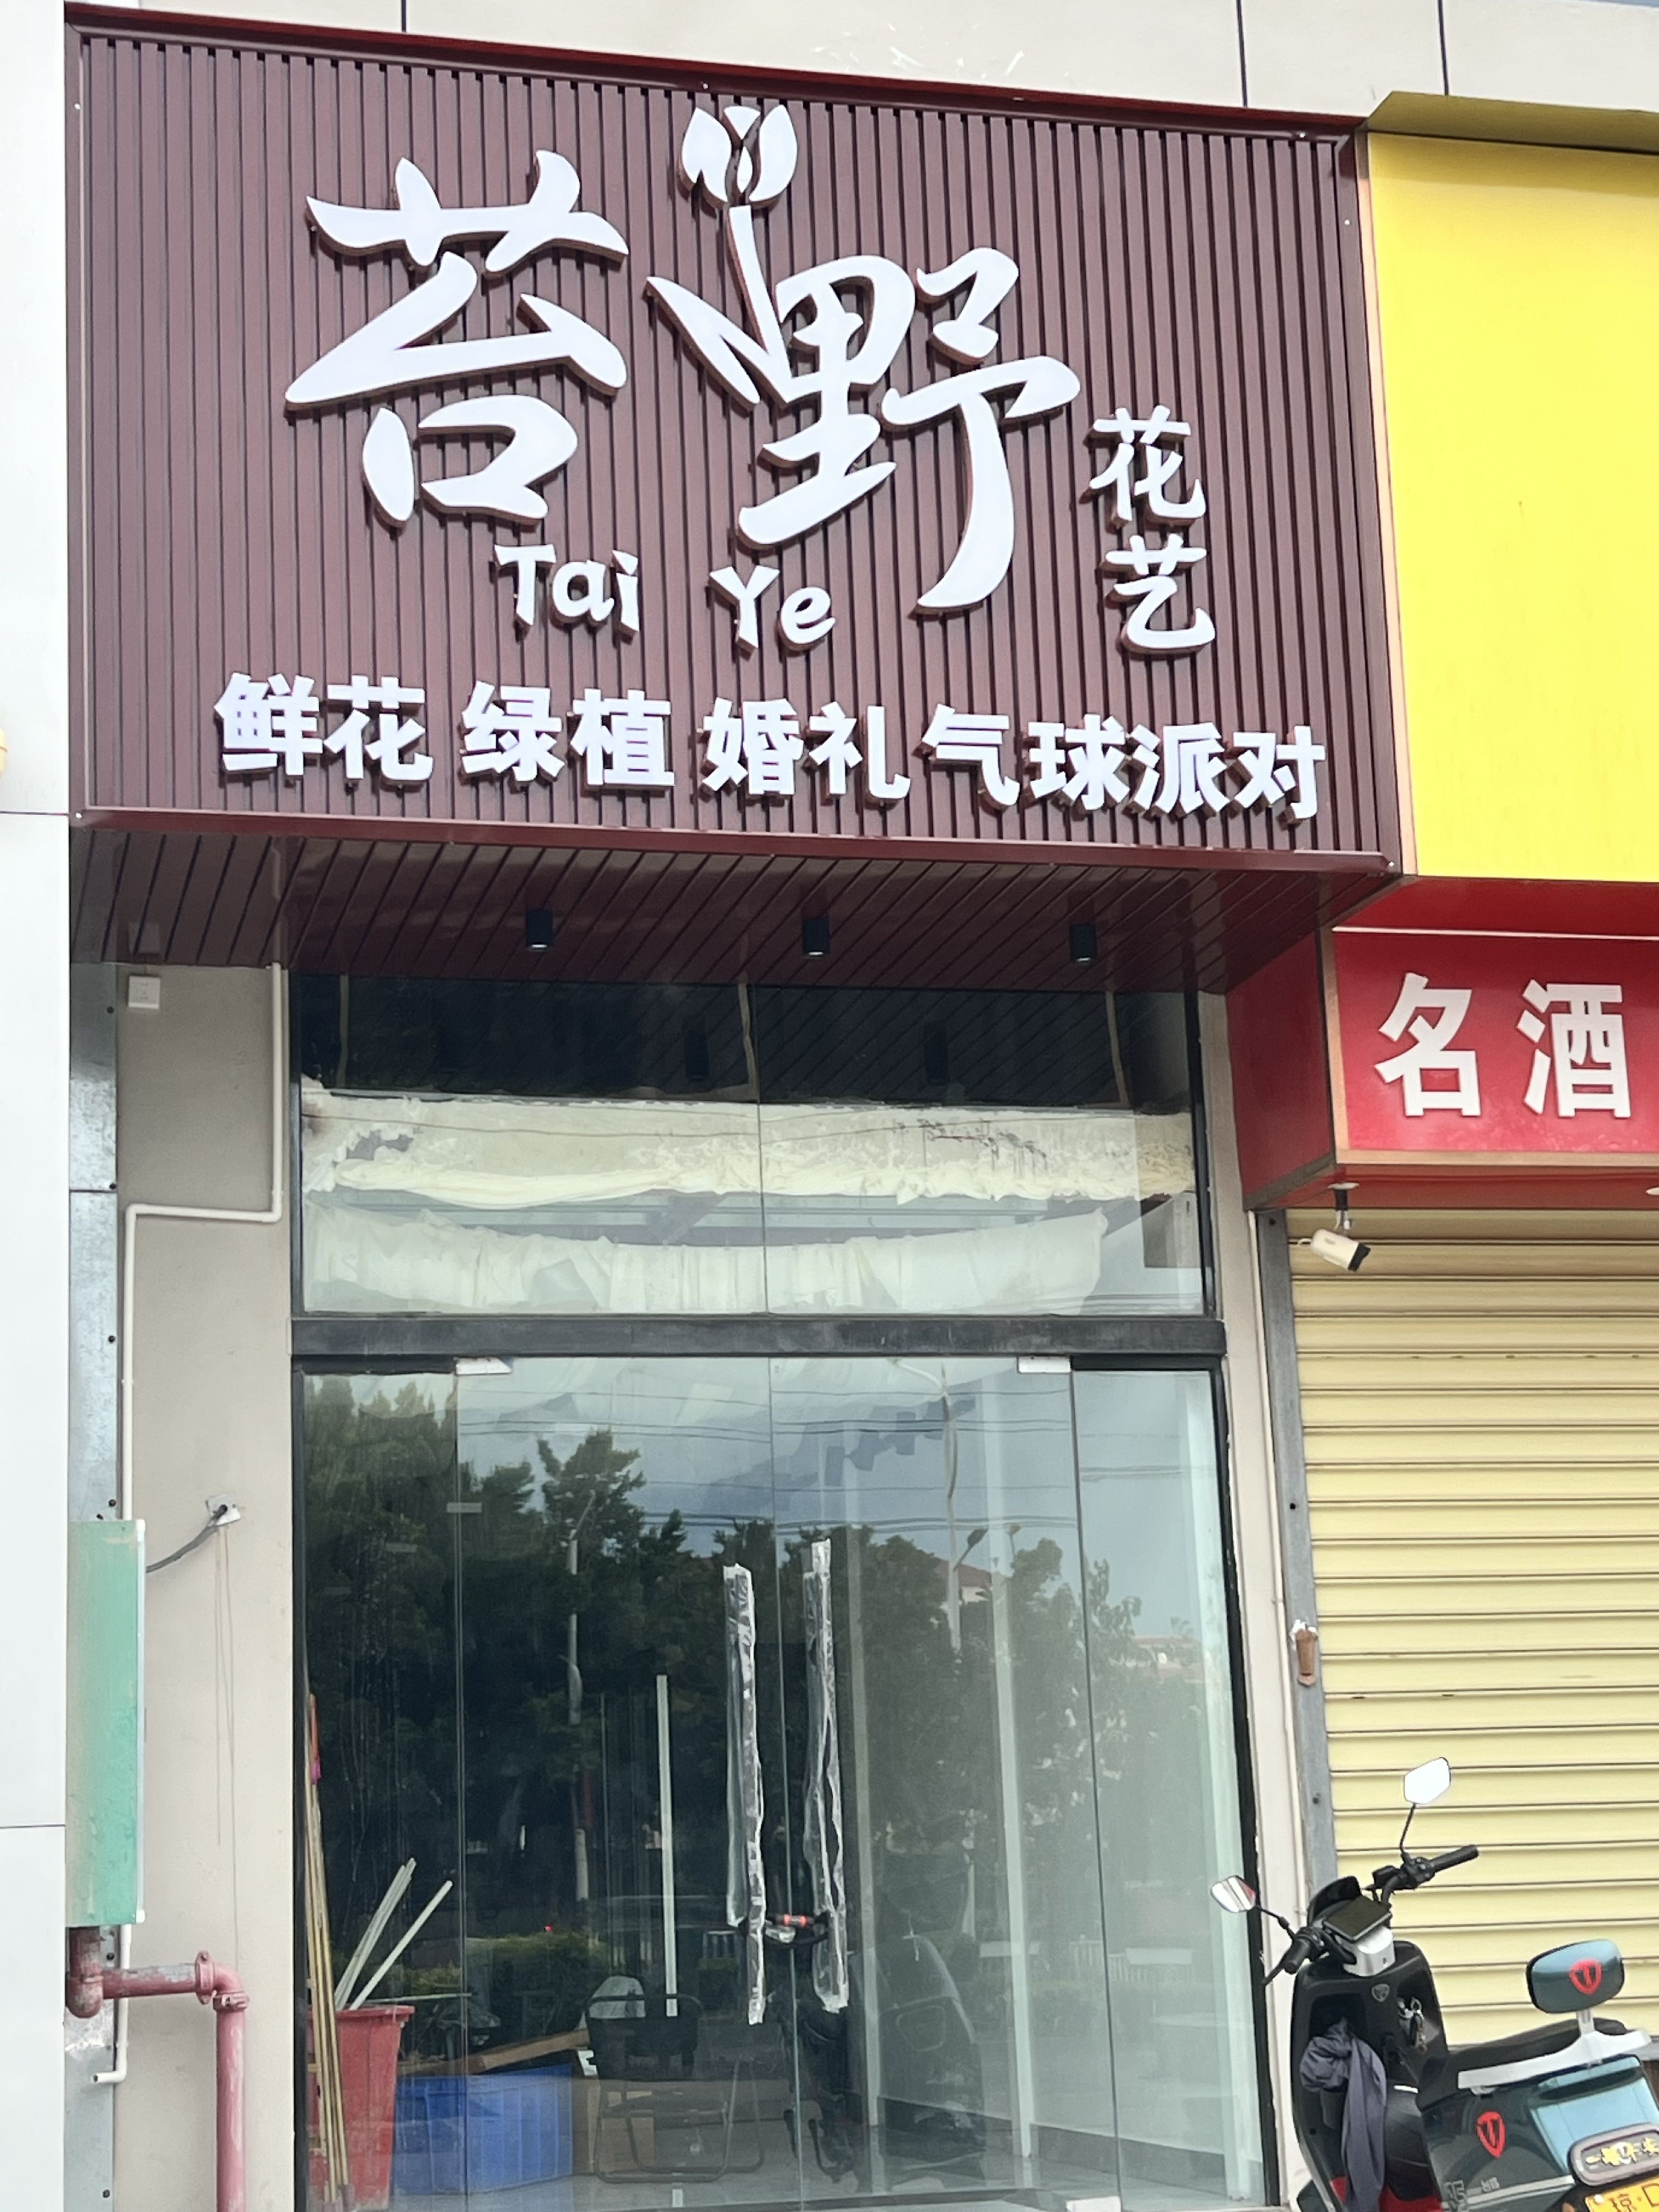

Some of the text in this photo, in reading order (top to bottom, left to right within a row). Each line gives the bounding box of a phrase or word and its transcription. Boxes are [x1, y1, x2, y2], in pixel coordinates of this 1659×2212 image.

[1089, 405, 1216, 649] 花艺
[494, 544, 836, 648] Tai Ye
[214, 672, 434, 781] 鲜花
[461, 680, 675, 787] 绿植
[1374, 972, 1631, 1118] 名酒
